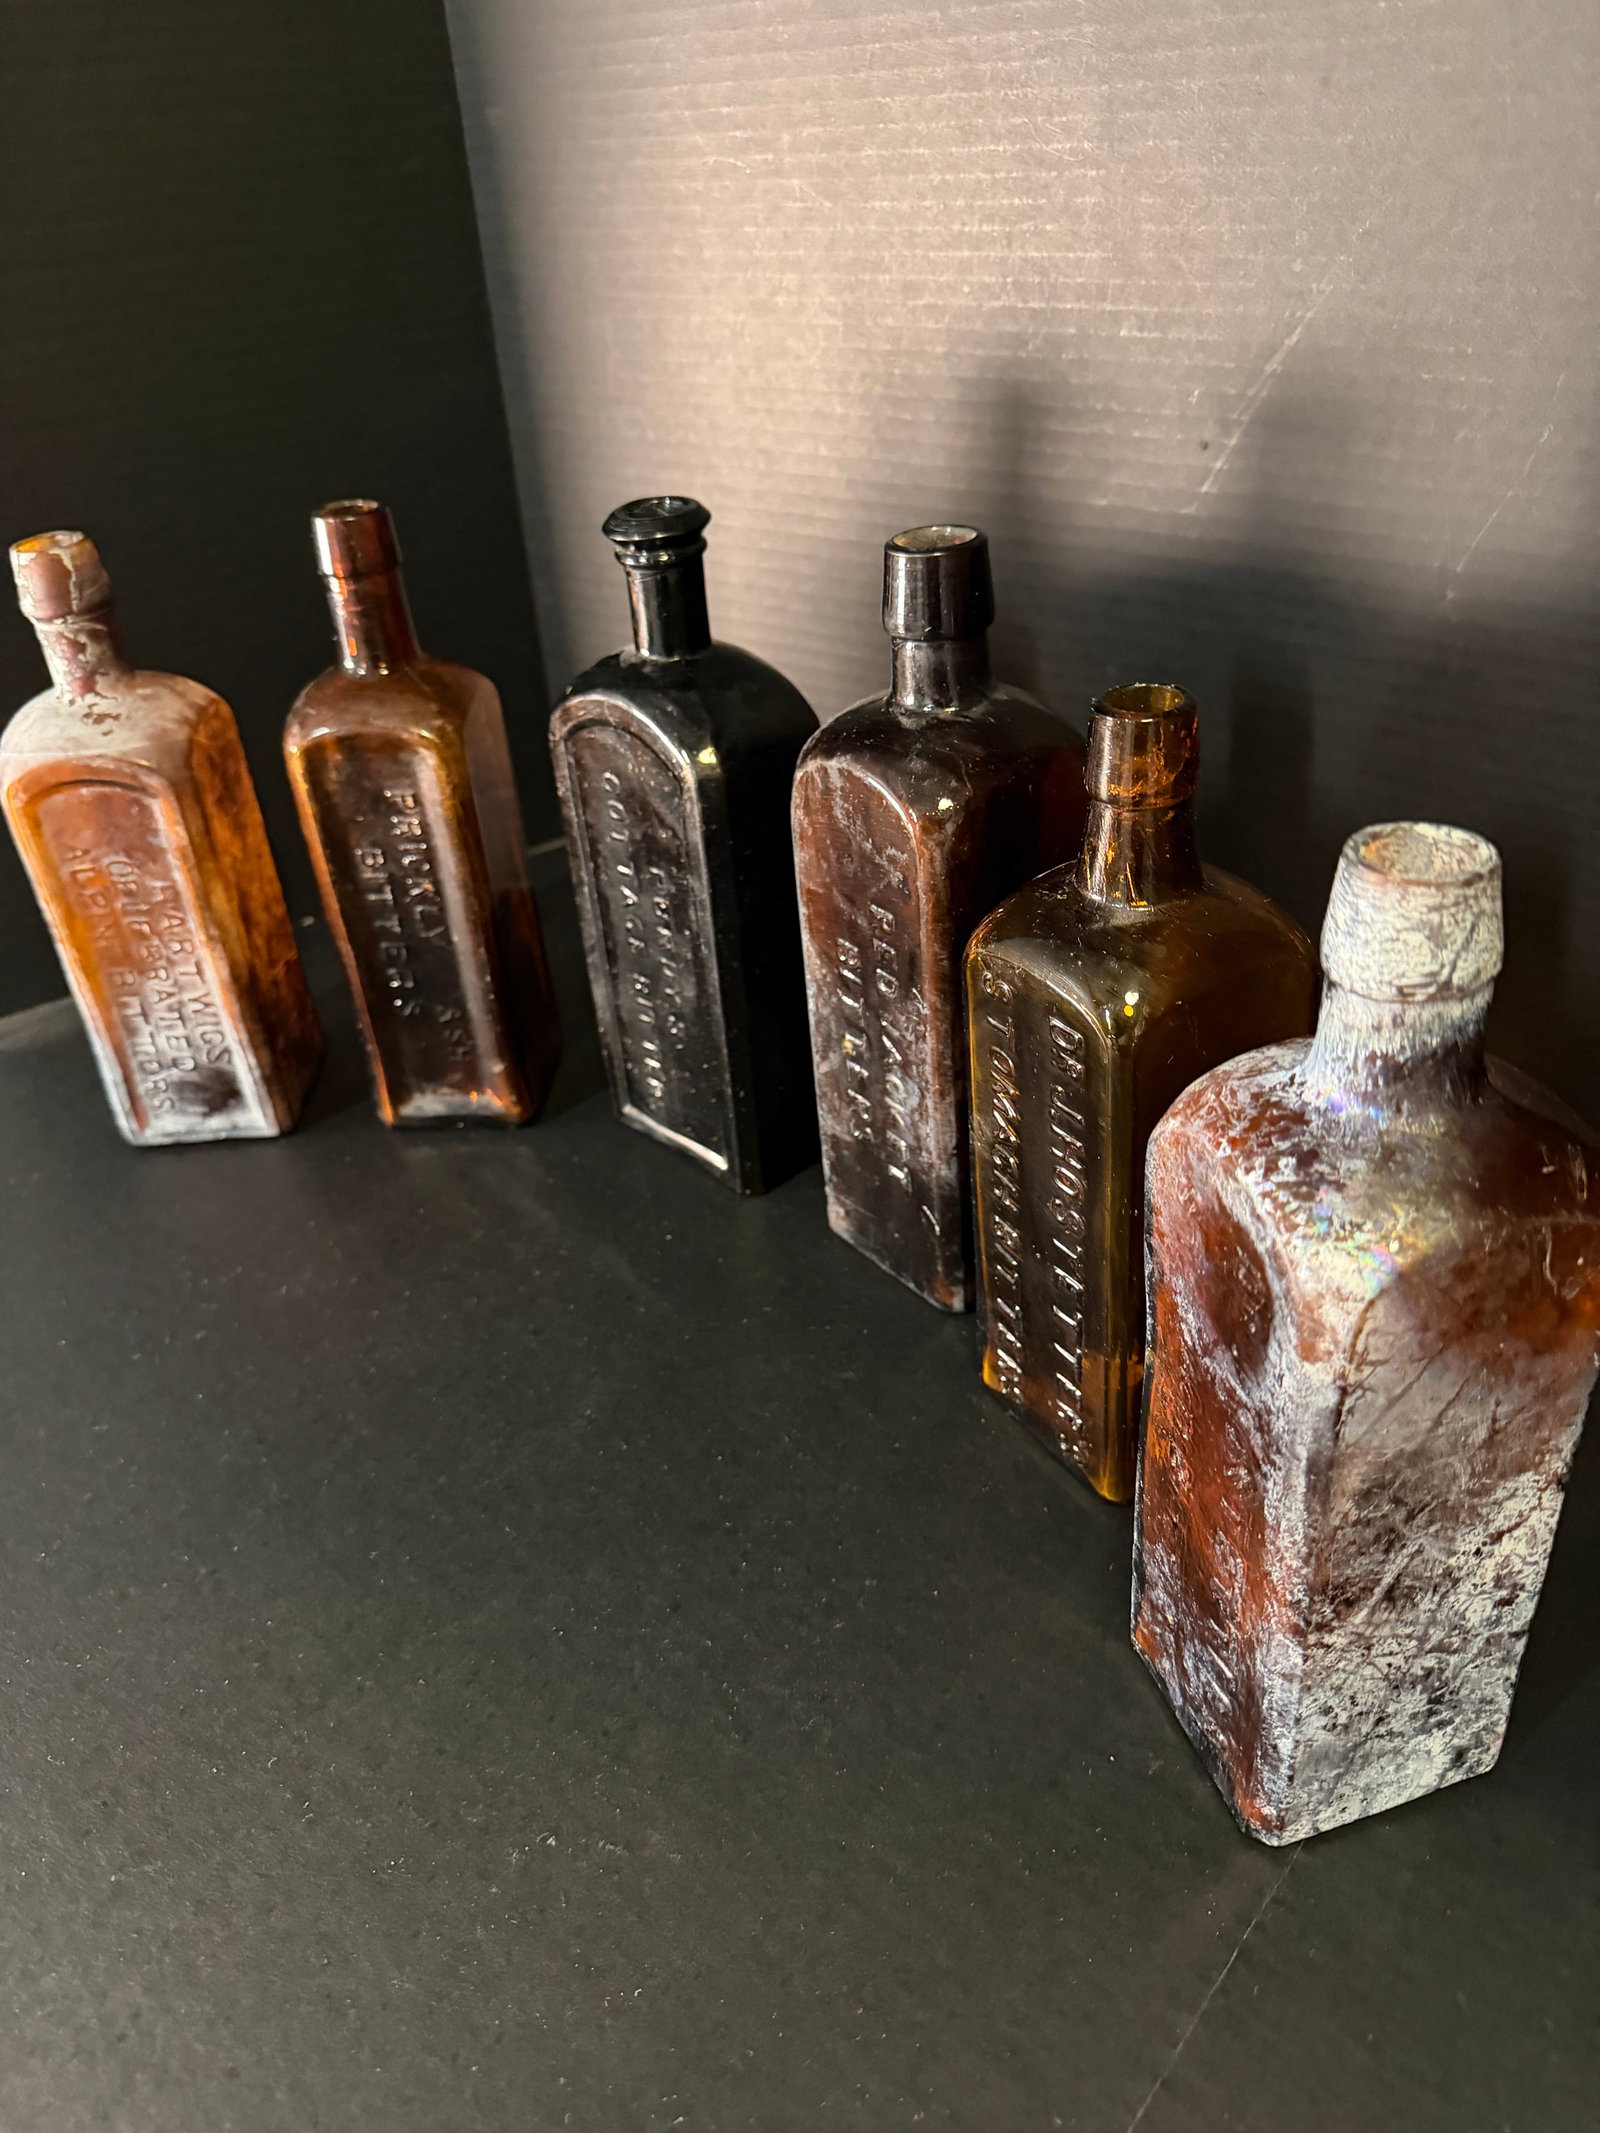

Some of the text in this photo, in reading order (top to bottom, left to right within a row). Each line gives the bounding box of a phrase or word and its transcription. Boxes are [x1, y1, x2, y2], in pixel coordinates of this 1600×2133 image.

[353, 847, 421, 1017] BITTERS
[384, 788, 477, 1062] PRICKLY ASH
[868, 902, 898, 1000] RED
[835, 937, 874, 1143] BITTERS
[980, 970, 1022, 1214] STOMACH
